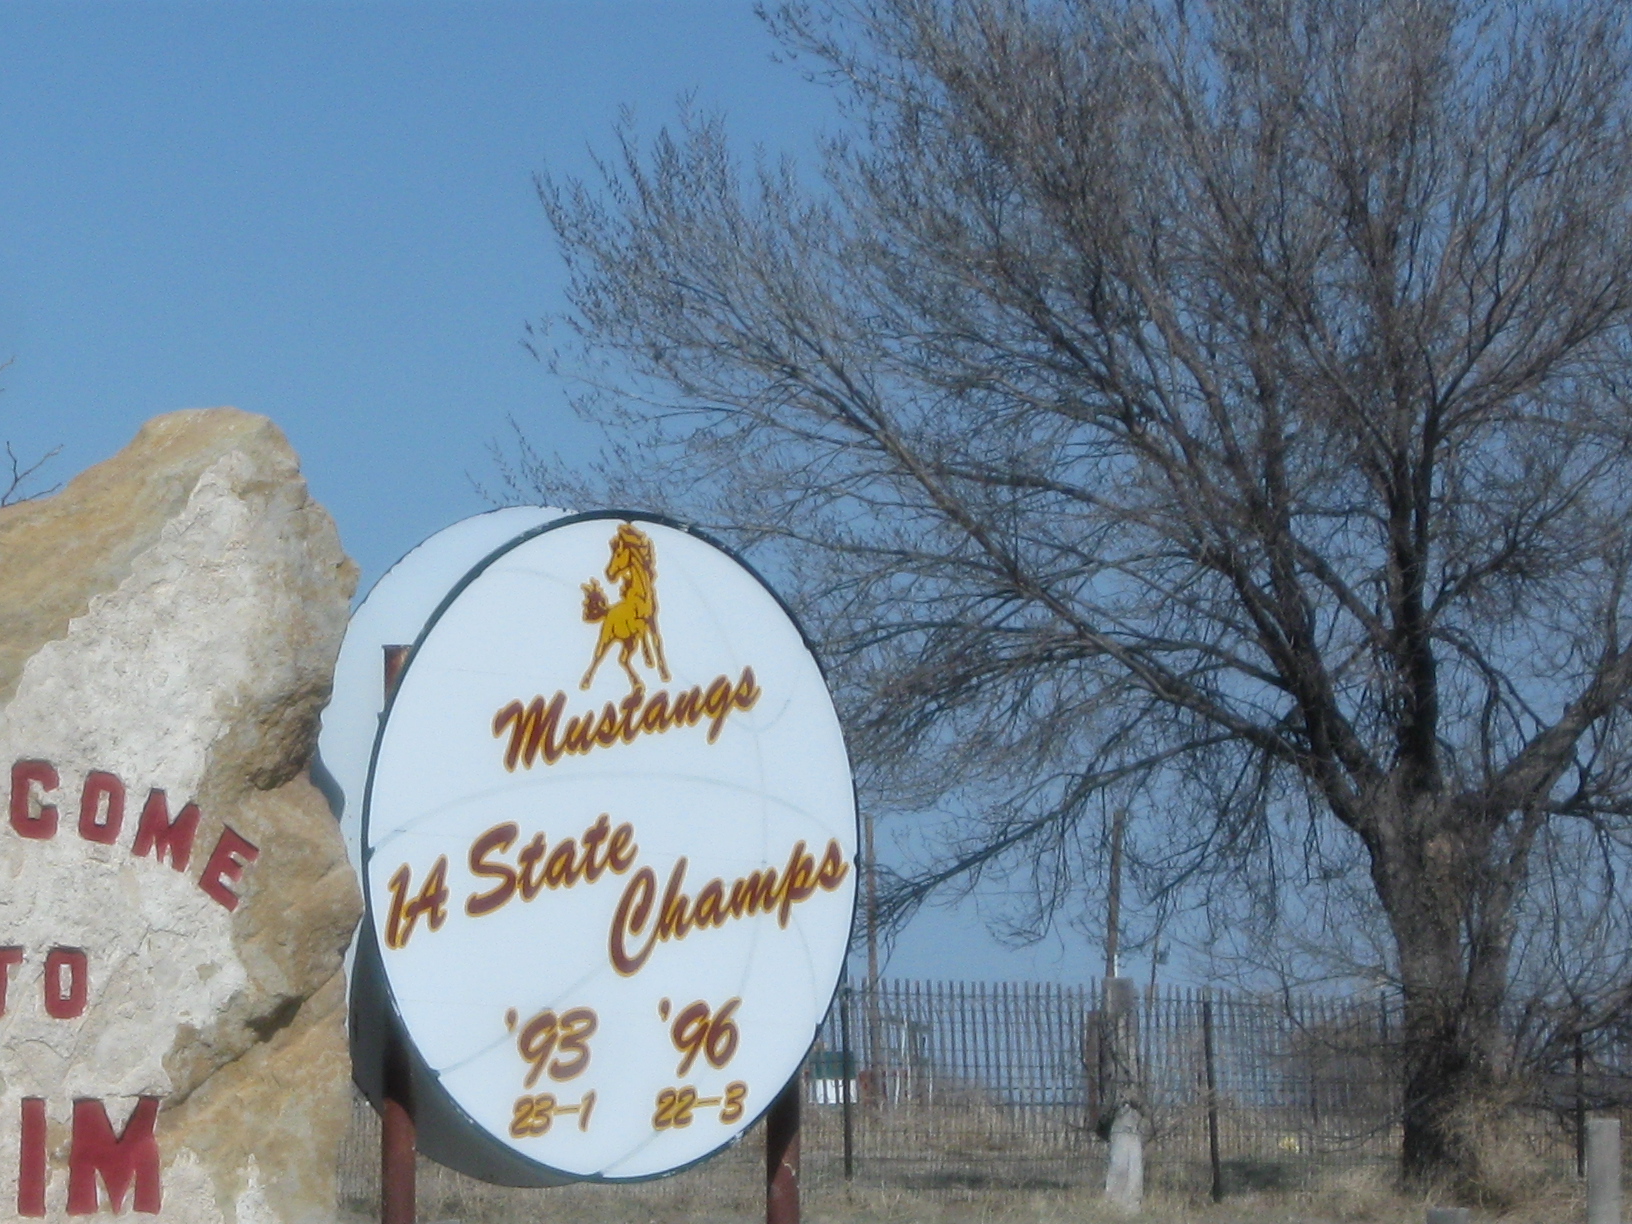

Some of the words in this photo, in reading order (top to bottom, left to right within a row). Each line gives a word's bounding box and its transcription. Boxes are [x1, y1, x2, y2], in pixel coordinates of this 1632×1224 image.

[492, 666, 762, 772] Mustangs
[384, 855, 448, 948] 1A
[465, 814, 638, 917] State
[609, 838, 849, 977] Champs
[504, 1007, 598, 1089] '93
[658, 997, 743, 1077] '96
[510, 1091, 597, 1138] 23-1
[652, 1080, 747, 1131] 22-3
